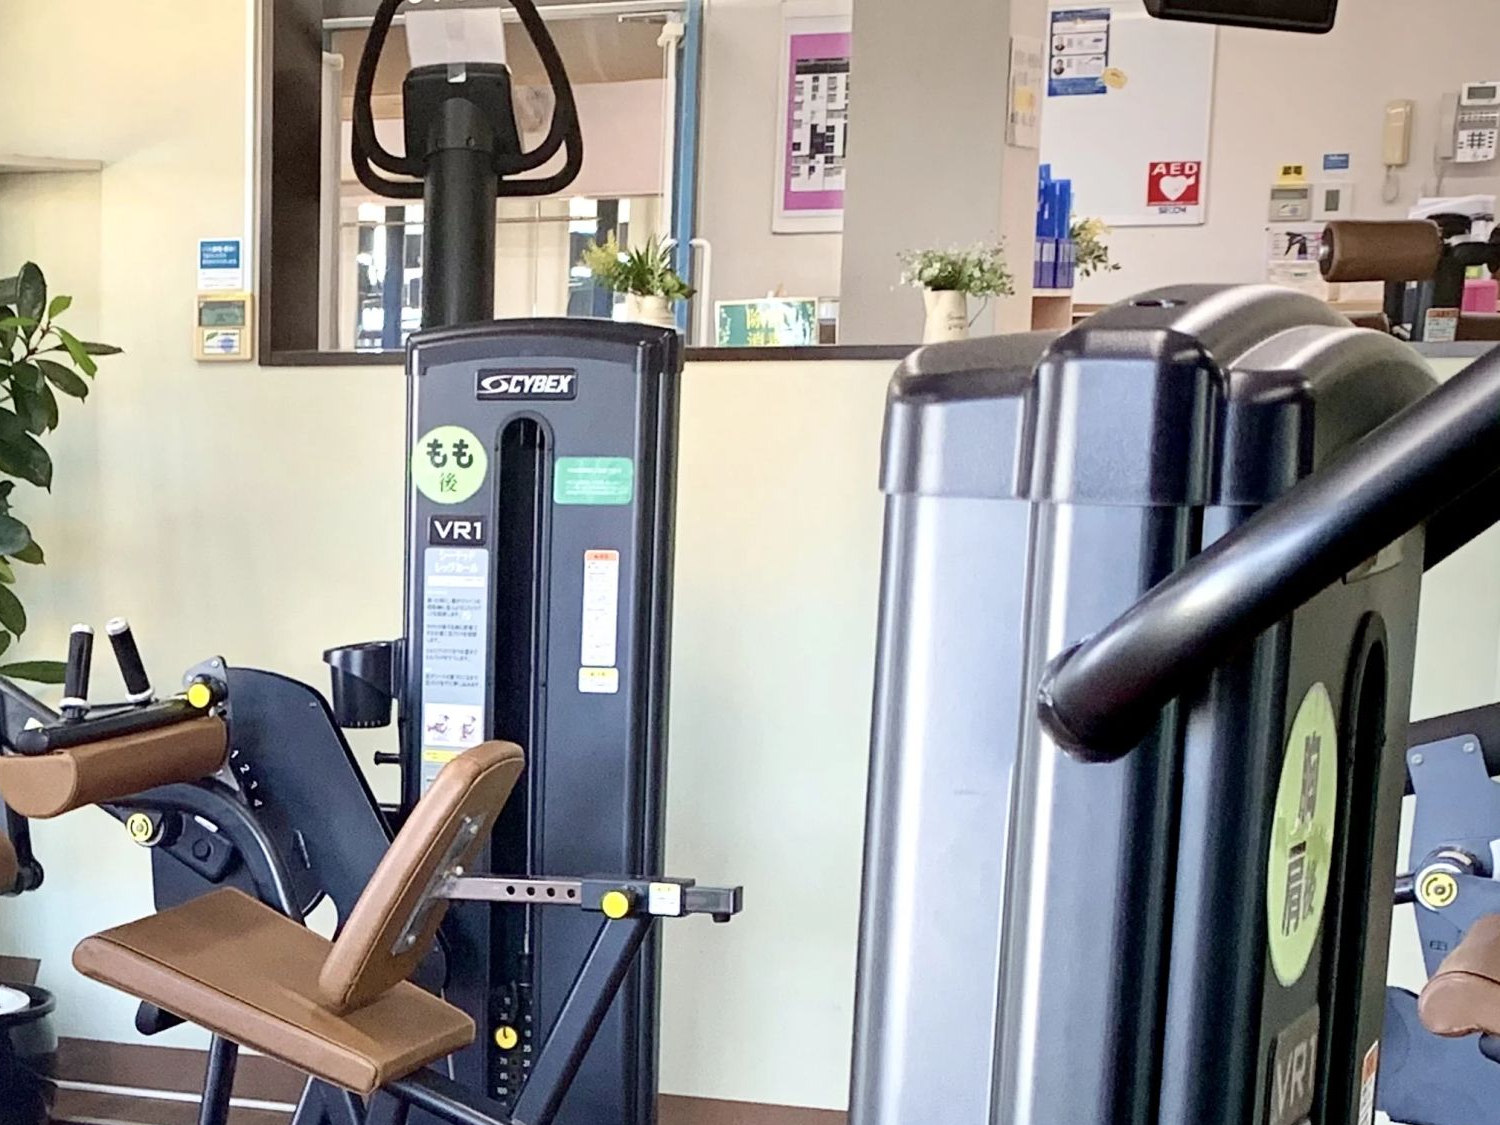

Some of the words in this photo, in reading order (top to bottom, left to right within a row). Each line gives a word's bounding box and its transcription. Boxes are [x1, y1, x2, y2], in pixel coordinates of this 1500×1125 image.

[1151, 163, 1198, 176] AED
[508, 374, 575, 394] CYBEX
[426, 438, 474, 469] もも
[439, 472, 459, 494] 後
[433, 521, 482, 540] VR1
[240, 763, 251, 775] 2
[1277, 1033, 1318, 1118] VR1
